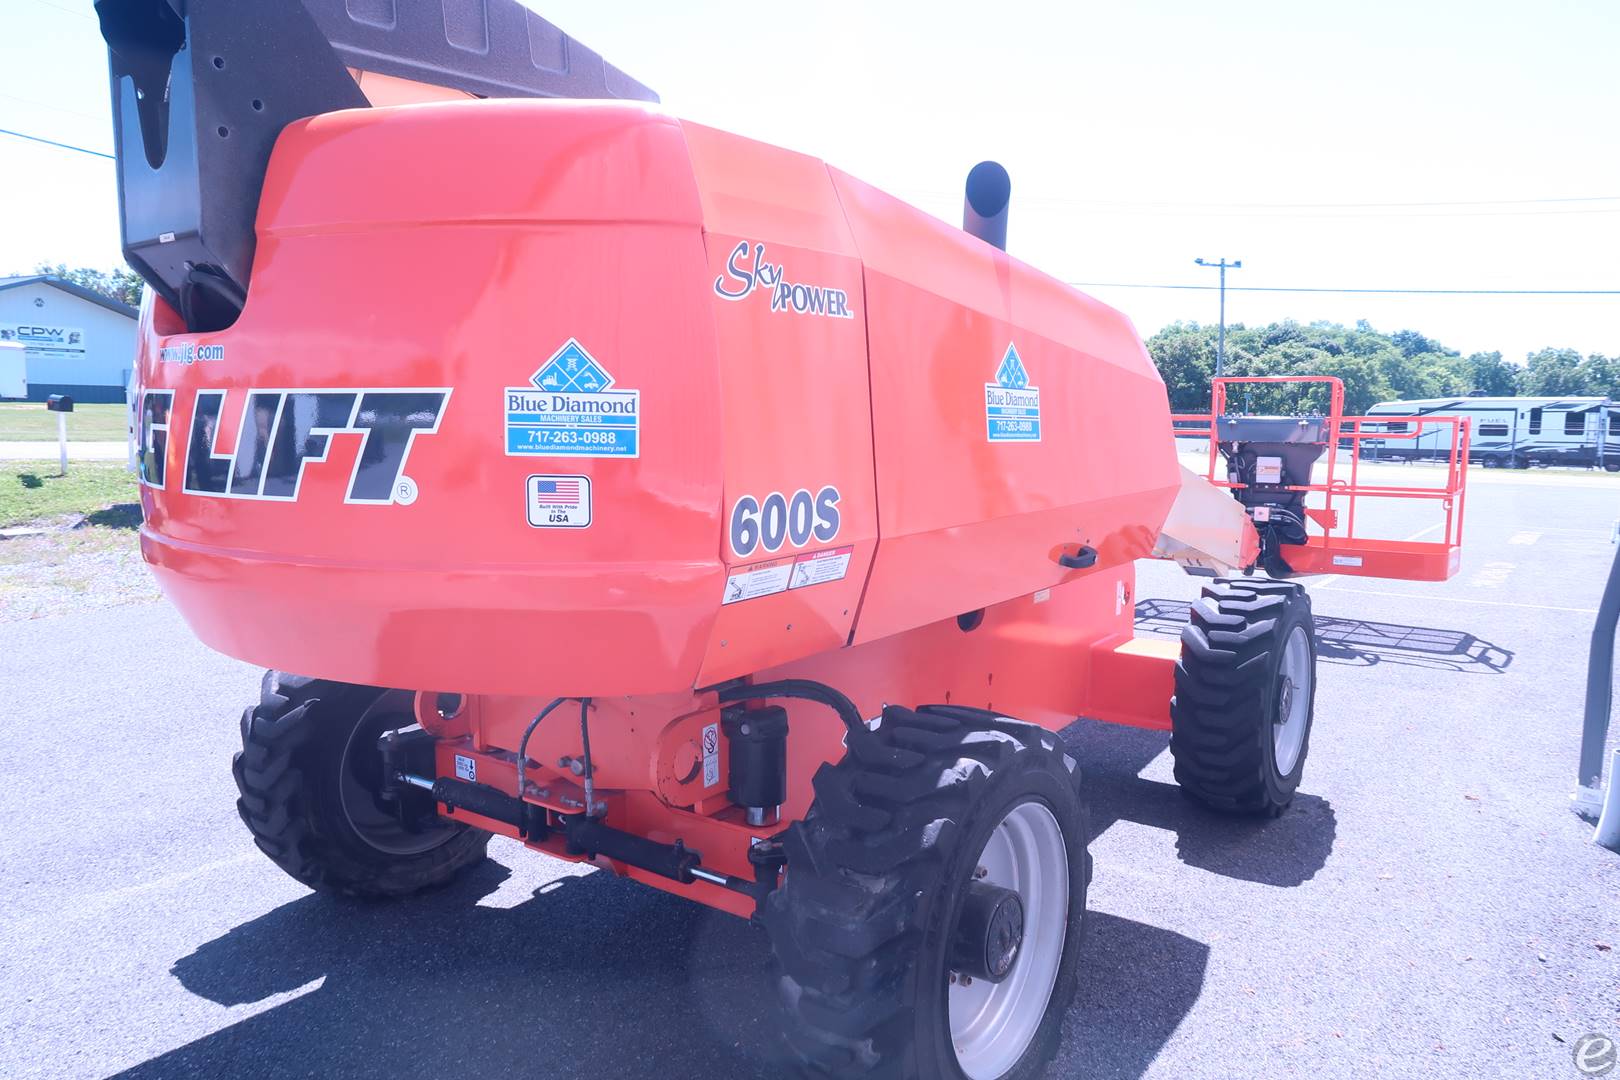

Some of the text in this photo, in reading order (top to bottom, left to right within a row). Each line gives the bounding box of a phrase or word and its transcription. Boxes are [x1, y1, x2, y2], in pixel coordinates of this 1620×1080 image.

[714, 240, 783, 310] Sky
[779, 282, 849, 317] POWER
[17, 326, 64, 336] CPW
[508, 394, 636, 414] Blue Diamond
[987, 390, 1039, 407] Blue Diamond
[540, 414, 602, 423] MACHINERY SALES
[527, 430, 616, 444] 717-263-0988
[183, 387, 453, 505] LIFT
[517, 444, 627, 452] www.bluediamondmachinery.net
[549, 514, 569, 523] USA
[731, 487, 840, 556] 600S
